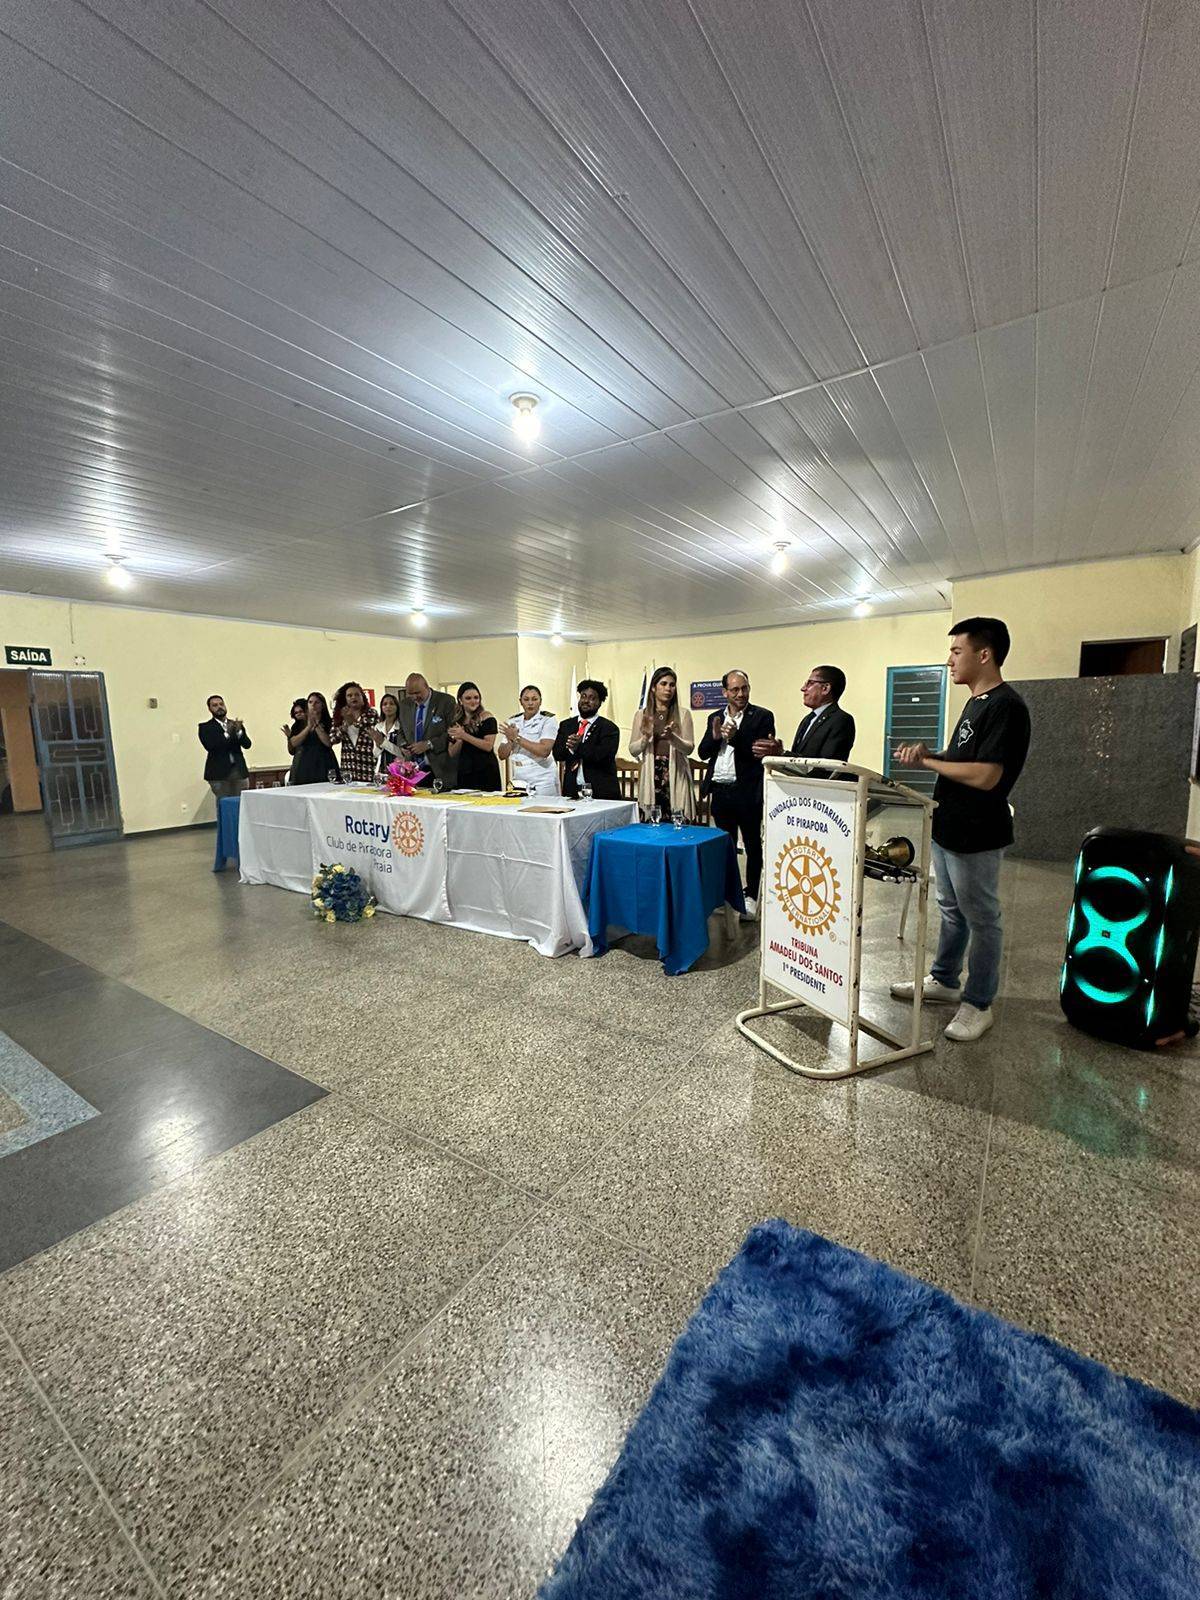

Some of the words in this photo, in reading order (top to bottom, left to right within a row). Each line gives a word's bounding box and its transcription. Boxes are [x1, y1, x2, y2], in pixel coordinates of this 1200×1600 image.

[10, 649, 48, 662] SAÍDA
[769, 796, 797, 820] FUNDAÇÃO
[798, 797, 812, 808] DOS
[812, 799, 851, 837] ROTARIANOS
[786, 815, 795, 826] DE
[796, 817, 829, 834] PIRAPORA
[345, 815, 390, 843] Rotary
[326, 835, 345, 849] Club
[346, 839, 357, 852] de
[793, 848, 821, 861] ROTARY
[783, 893, 831, 925] INTERNATIONAL
[791, 937, 819, 958] TRIBUNA
[769, 940, 797, 961] AMADEU
[799, 953, 813, 970] DOS
[814, 962, 843, 986] SANTOS
[789, 966, 826, 994] PRESIDENTE
